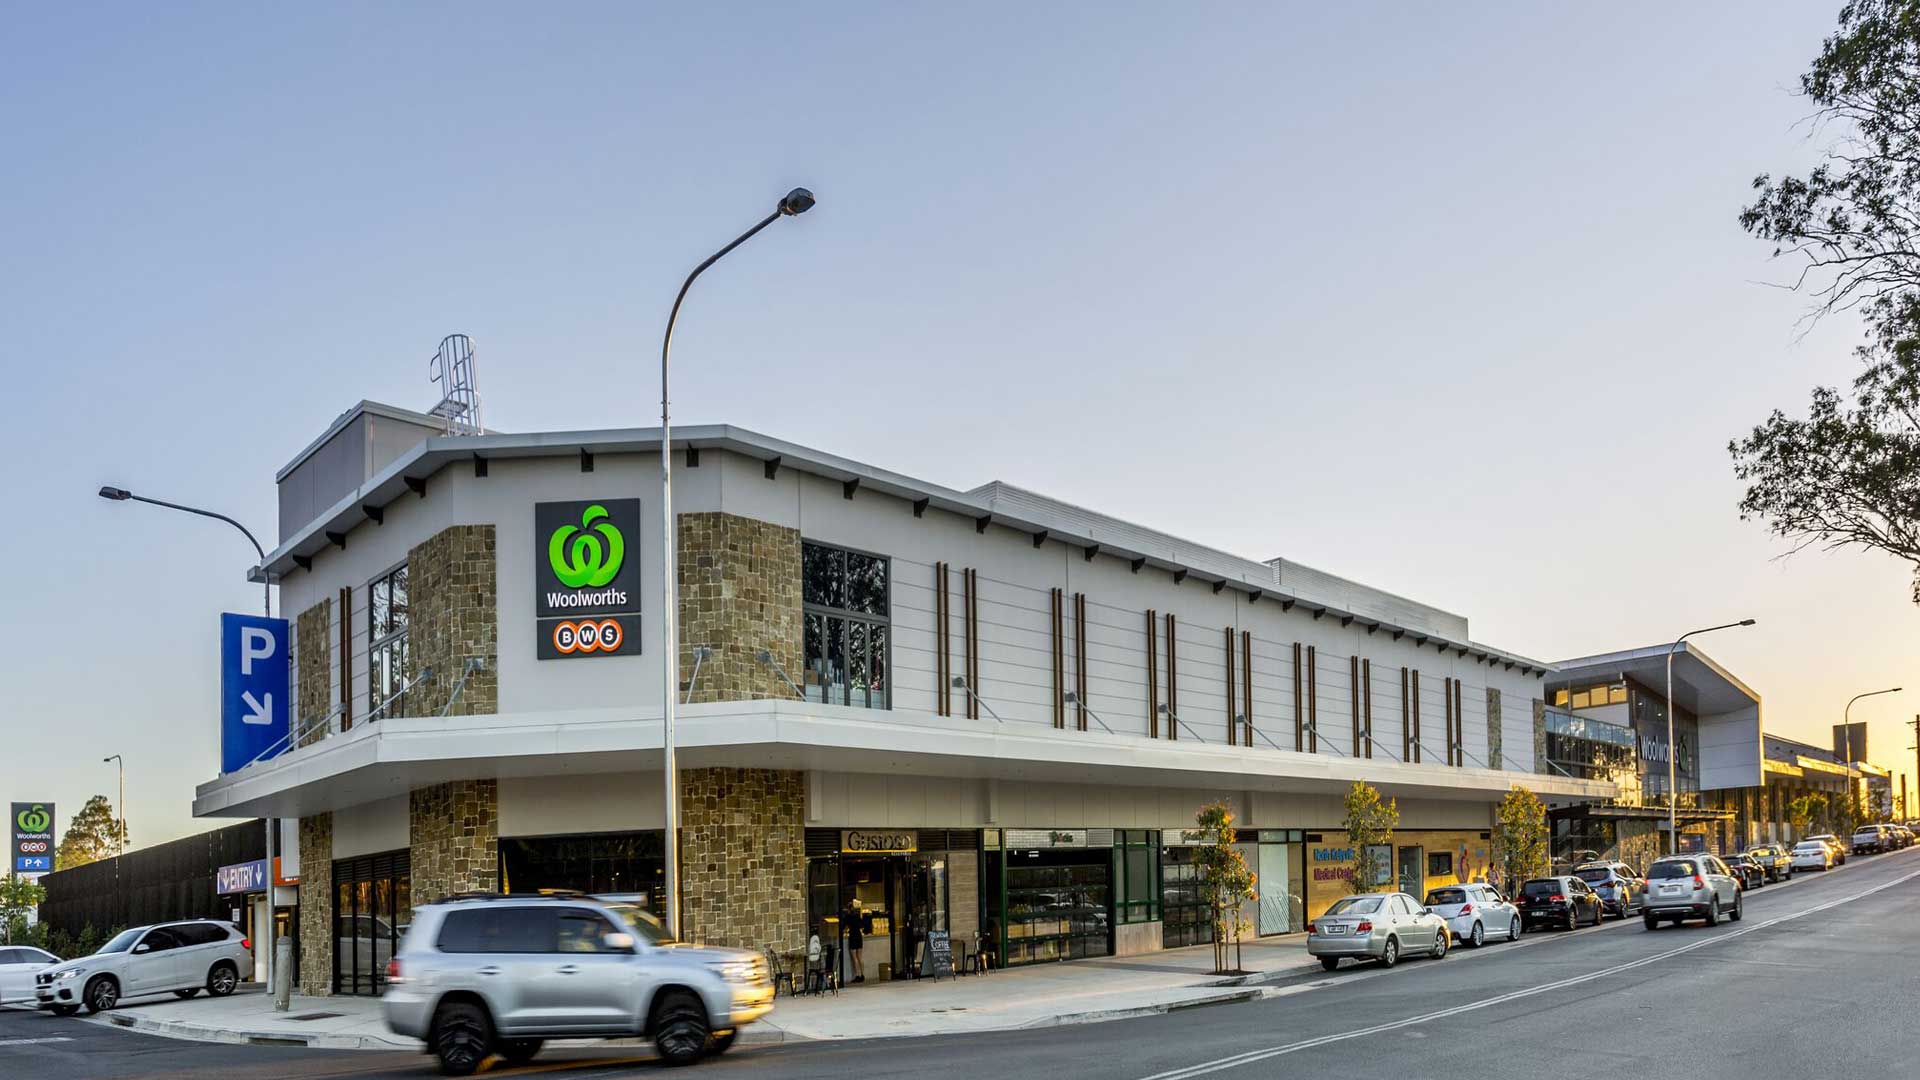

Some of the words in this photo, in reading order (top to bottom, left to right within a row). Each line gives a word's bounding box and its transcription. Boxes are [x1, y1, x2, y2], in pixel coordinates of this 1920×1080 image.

[547, 588, 627, 608] Woolworths
[241, 626, 276, 675] P
[1639, 735, 1679, 764] Woolwos
[25, 859, 33, 868] P
[230, 865, 254, 890] ENTRY
